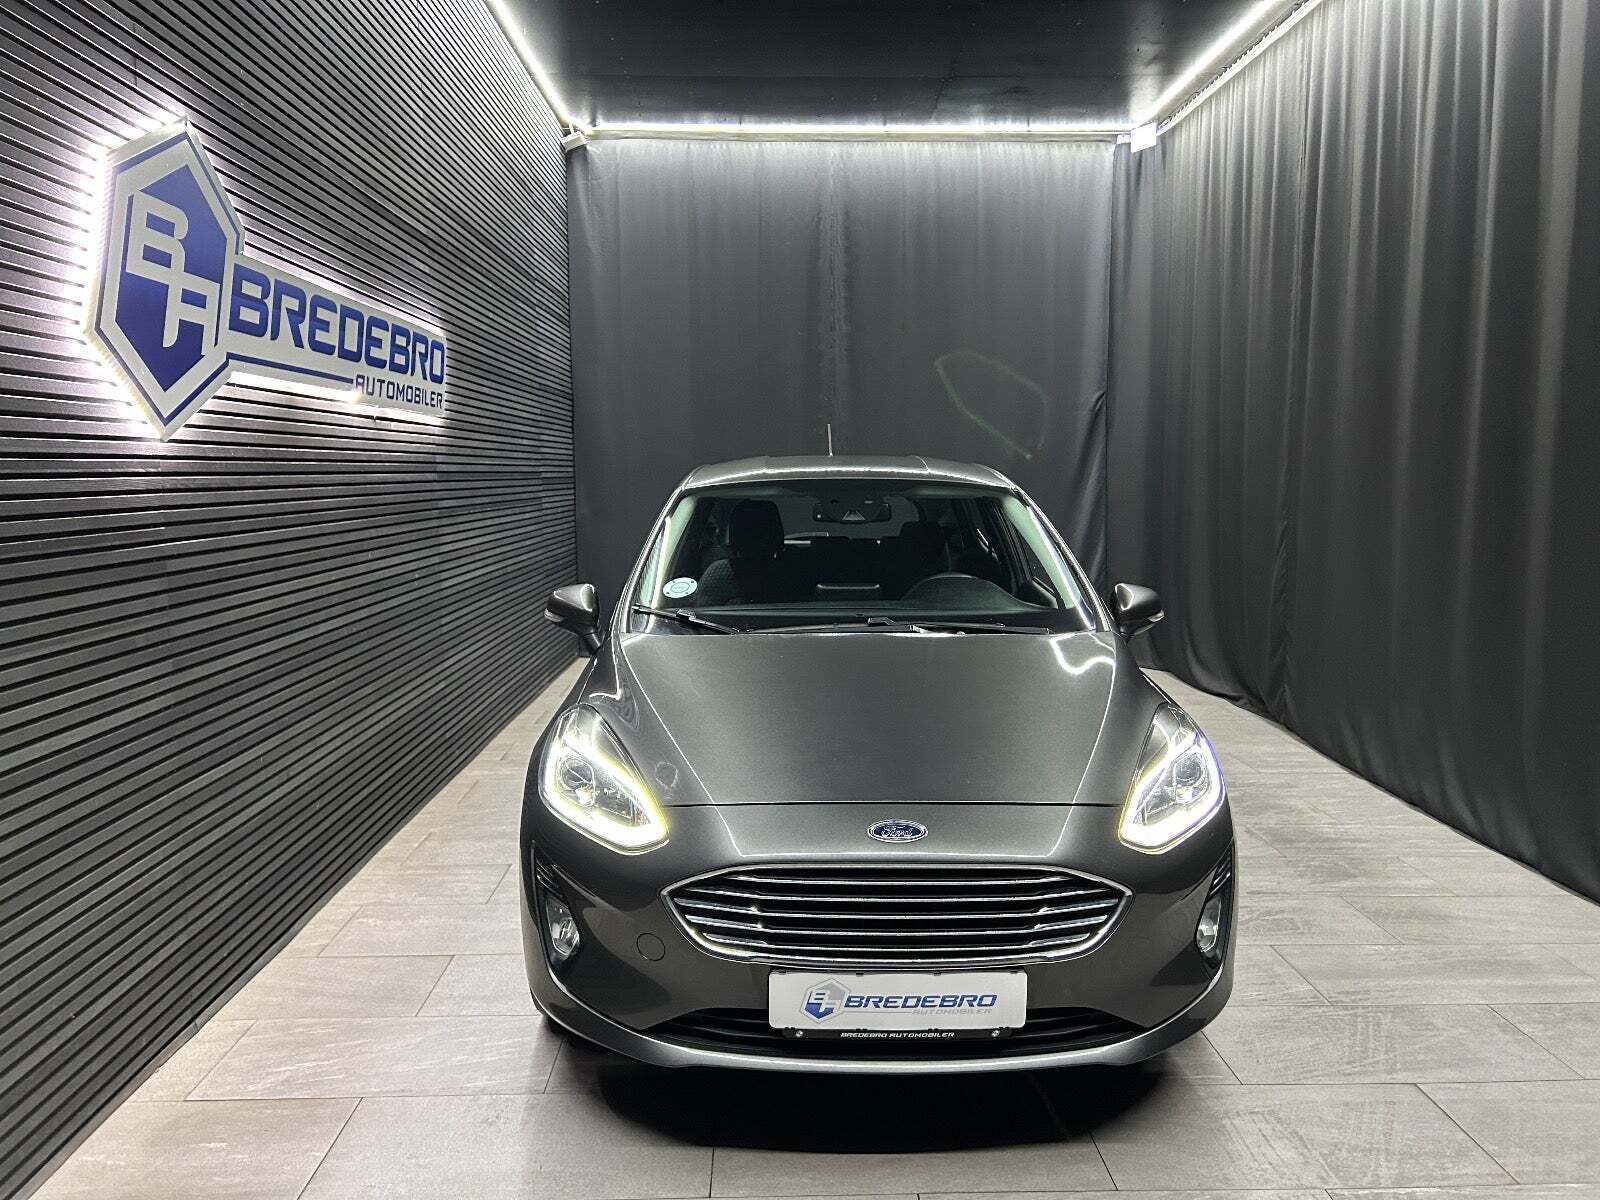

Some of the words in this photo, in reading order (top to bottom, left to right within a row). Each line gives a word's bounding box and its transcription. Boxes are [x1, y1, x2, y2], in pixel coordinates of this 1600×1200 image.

[229, 263, 445, 384] BREDEBRO
[356, 374, 443, 409] AUTOMOBILER
[844, 994, 998, 1008] BREDEBRO
